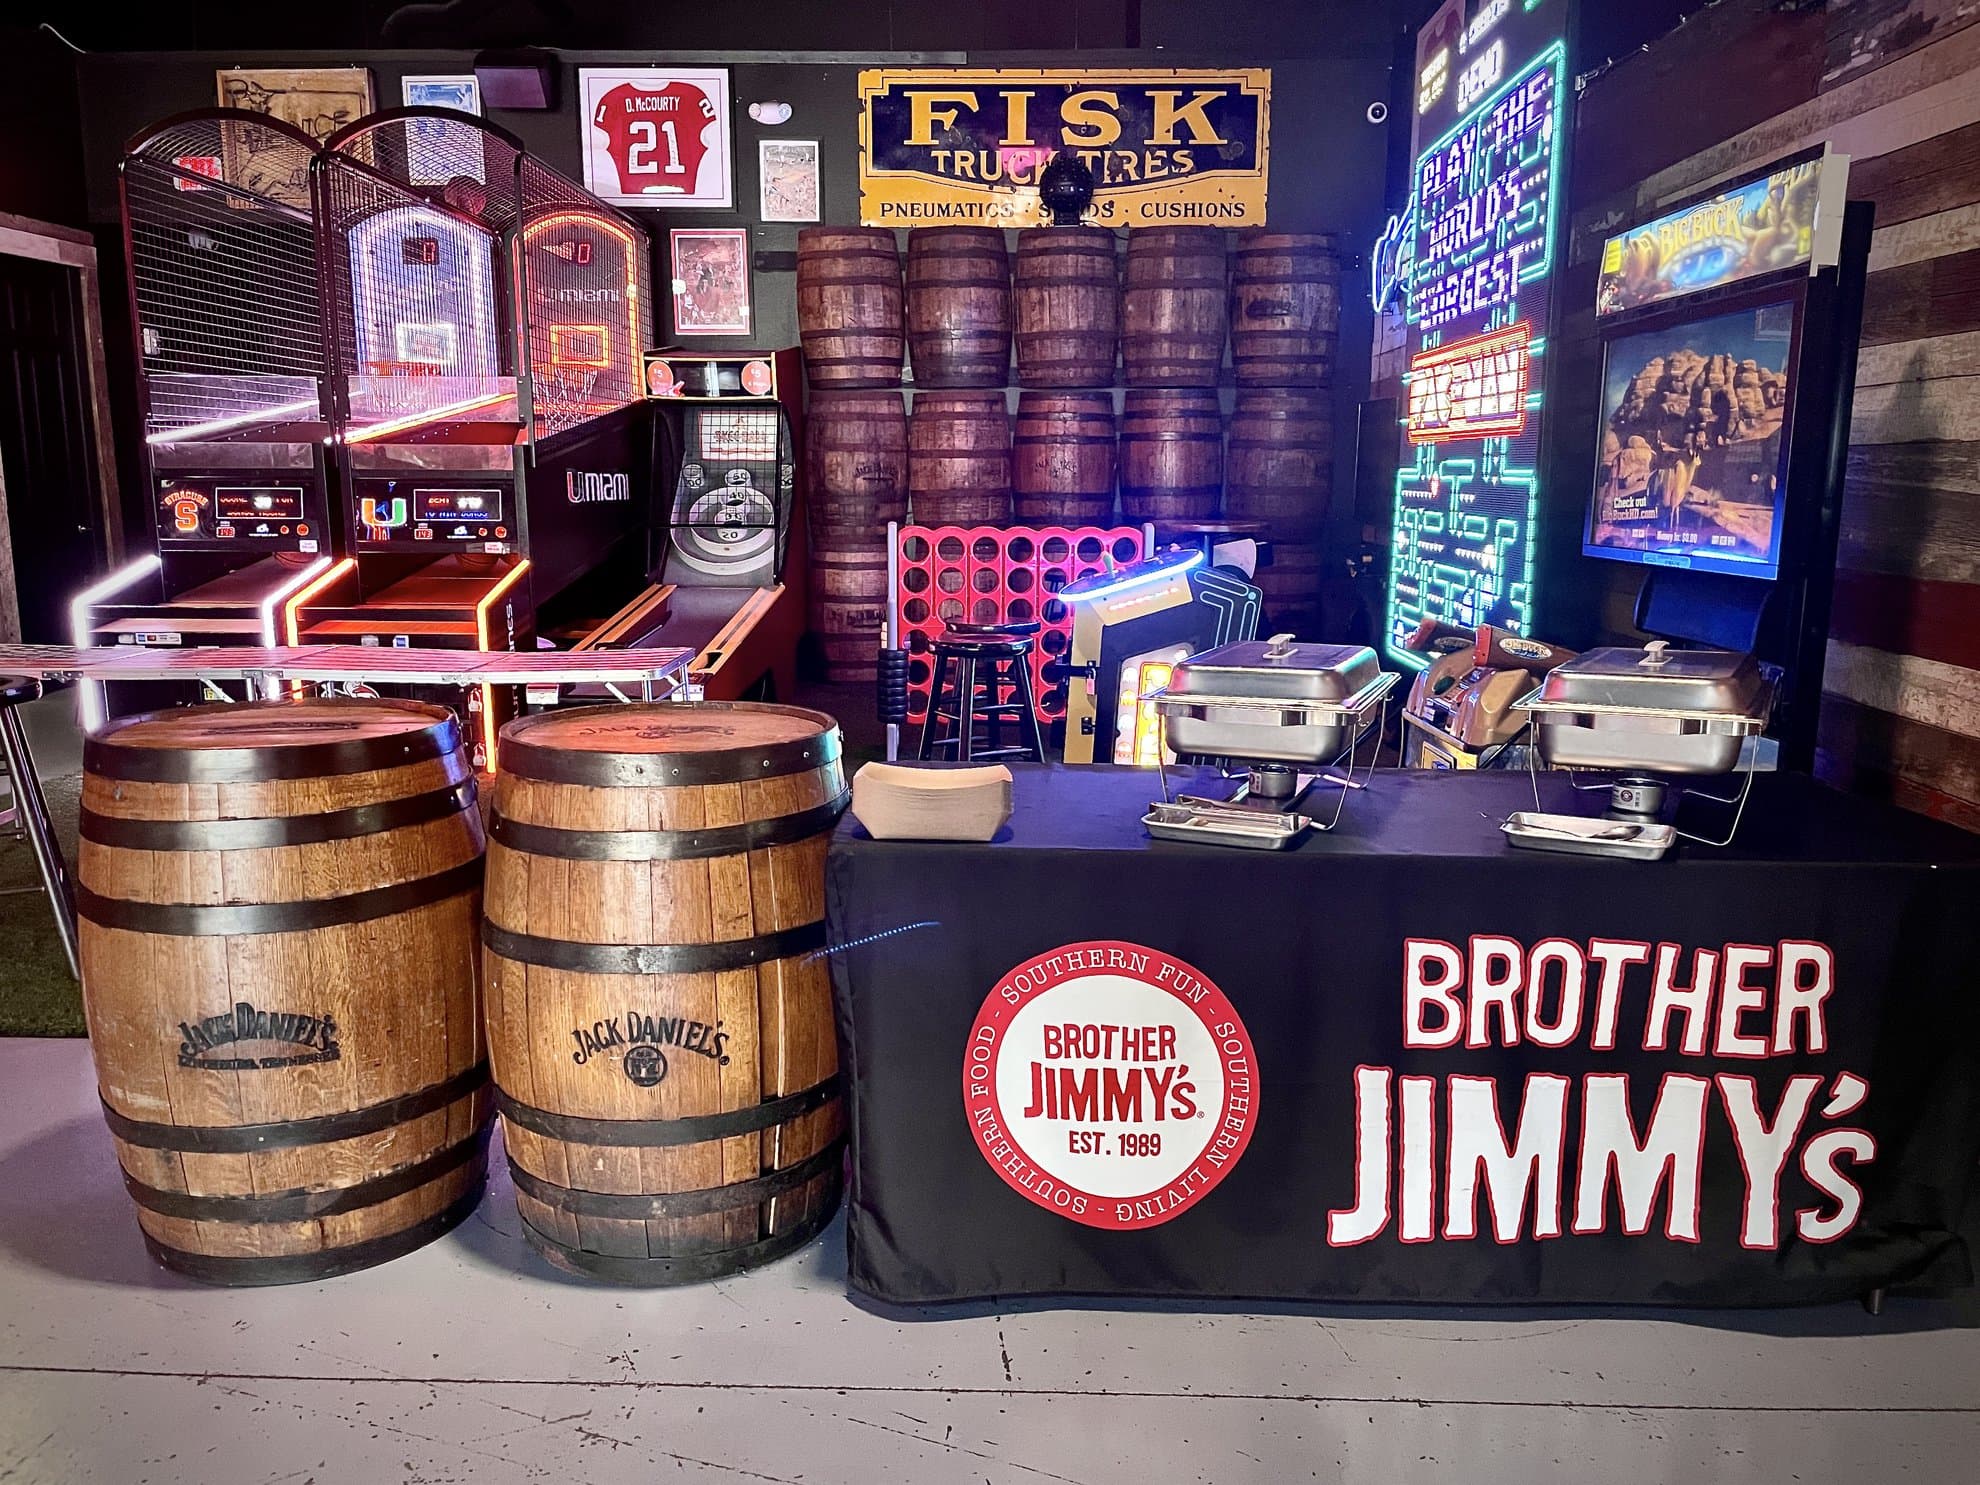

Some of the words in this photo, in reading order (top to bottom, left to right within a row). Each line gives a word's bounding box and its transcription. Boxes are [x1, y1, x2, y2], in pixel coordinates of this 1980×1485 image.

[636, 96, 680, 112] McCOURTY
[903, 90, 1228, 147] FISK
[628, 121, 686, 174] 21
[931, 149, 1058, 186] TRUCK
[1076, 149, 1195, 184] TIRES
[1422, 126, 1477, 205] PLAY
[880, 202, 1014, 219] PNEUMATICS
[1140, 202, 1246, 219] CUSHIONS
[1658, 219, 1688, 265] BIG
[1690, 195, 1745, 241] BUCK
[164, 490, 209, 506] SYRACUSE
[175, 501, 199, 531] S
[1613, 496, 1634, 509] Check
[1635, 496, 1647, 507] out
[722, 531, 738, 540] 20
[1000, 948, 1150, 1006] SOUTHERN
[1155, 961, 1210, 1004] FUN
[1402, 934, 1835, 1059] BROTHER
[178, 1013, 235, 1056] JACK
[235, 1002, 340, 1052] DANIEL'S
[571, 1017, 625, 1065] JACK
[626, 1011, 730, 1059] DANIEL'S
[1043, 1023, 1177, 1062] BROTHER
[970, 1026, 998, 1100] FOOD
[1213, 1020, 1251, 1170] SOUTHERN
[974, 1106, 1088, 1216] SOUTHERN
[1069, 1131, 1112, 1156] EST.
[1118, 1134, 1162, 1157] 1989
[1115, 1166, 1210, 1223] LIVING
